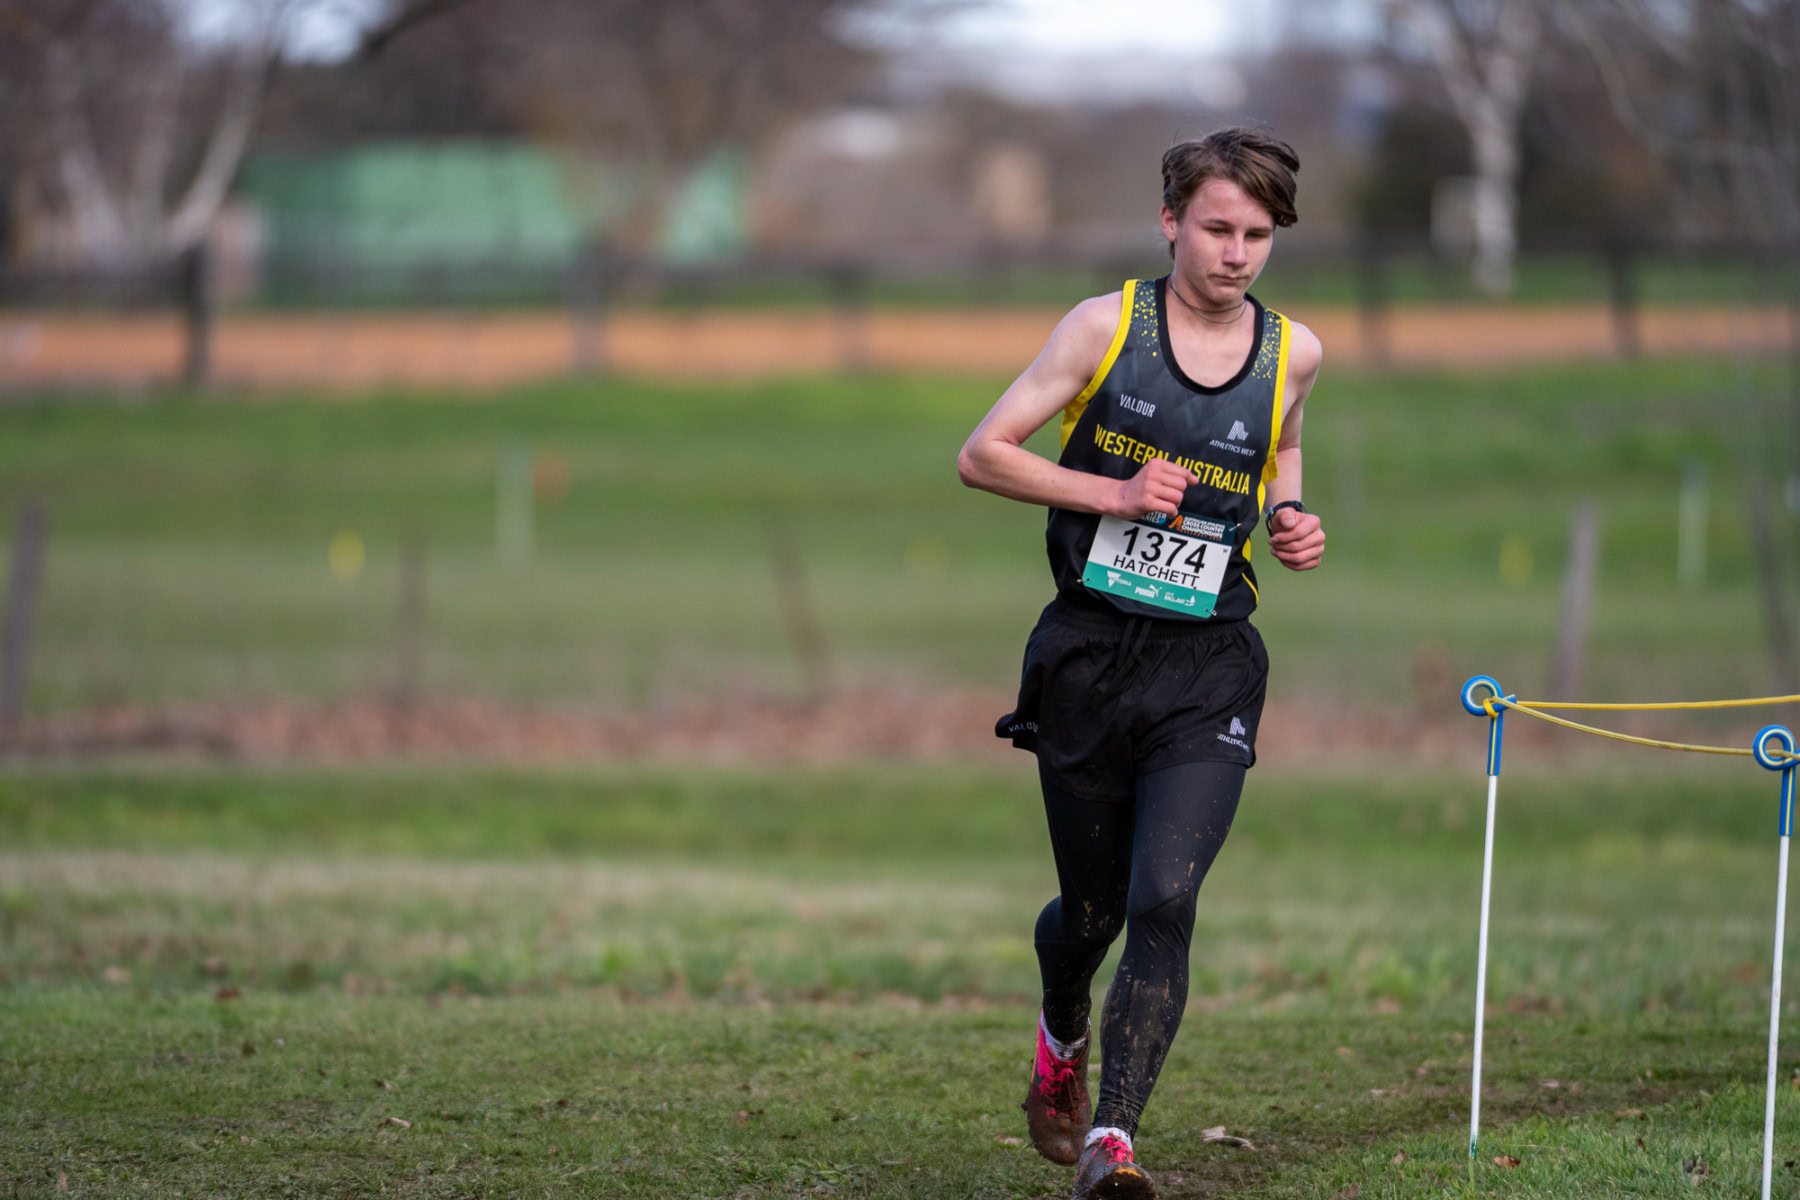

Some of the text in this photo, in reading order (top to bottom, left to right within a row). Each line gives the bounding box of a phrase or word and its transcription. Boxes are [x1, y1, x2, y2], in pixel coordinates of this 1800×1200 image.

[1119, 393, 1156, 418] VALOUR
[1209, 439, 1256, 456] ATHLETICS WEST
[1181, 525, 1223, 539] CHAMPIONSHIPS
[1183, 520, 1224, 534] CROSS COUNTRY
[1123, 526, 1207, 574] 1374
[1113, 554, 1200, 587] HATCHETT
[1134, 586, 1156, 599] PUMA
